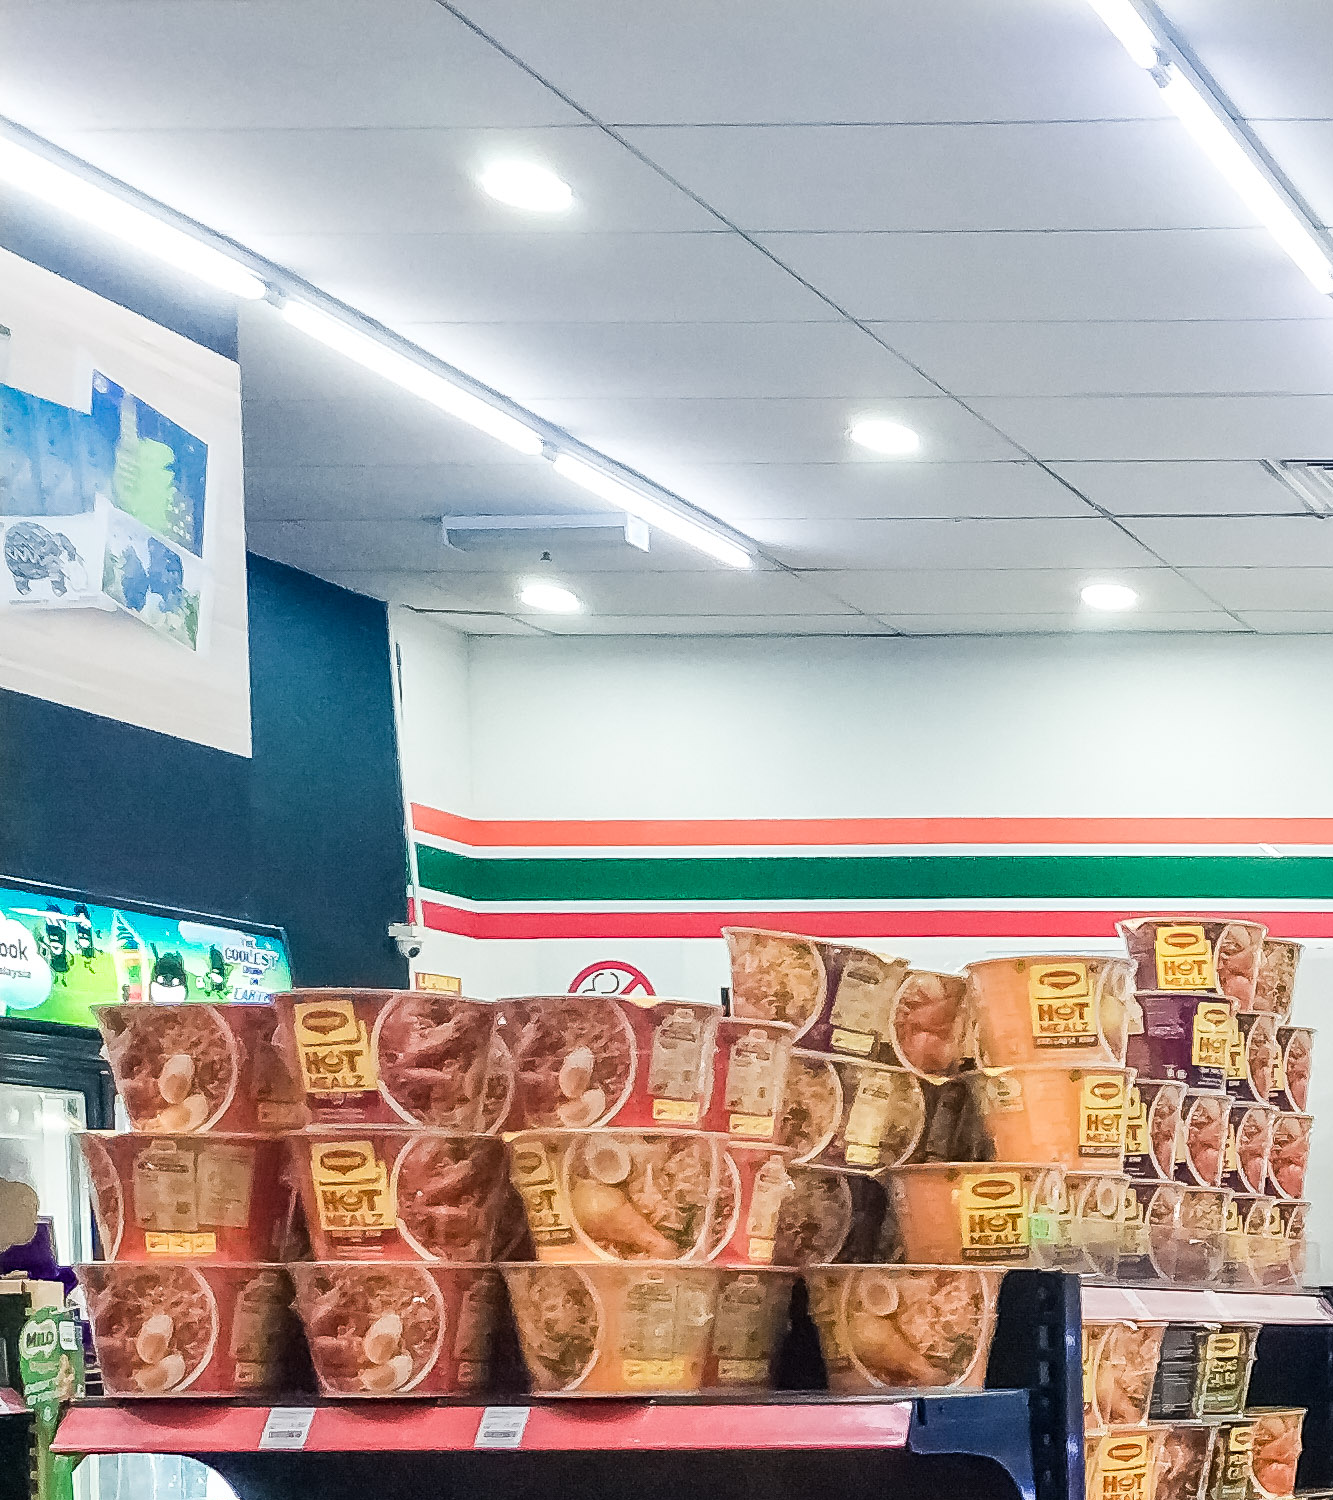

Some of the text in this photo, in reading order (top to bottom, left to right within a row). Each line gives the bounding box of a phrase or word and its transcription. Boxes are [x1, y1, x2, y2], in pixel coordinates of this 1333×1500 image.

[1163, 959, 1208, 977] HOT
[1038, 1002, 1090, 1022] HOT
[305, 1049, 364, 1075] HOT
[1087, 1114, 1122, 1132] HOT
[320, 1189, 382, 1212] HOT
[969, 1213, 1021, 1233] HOT
[1103, 1472, 1146, 1493] HOT
